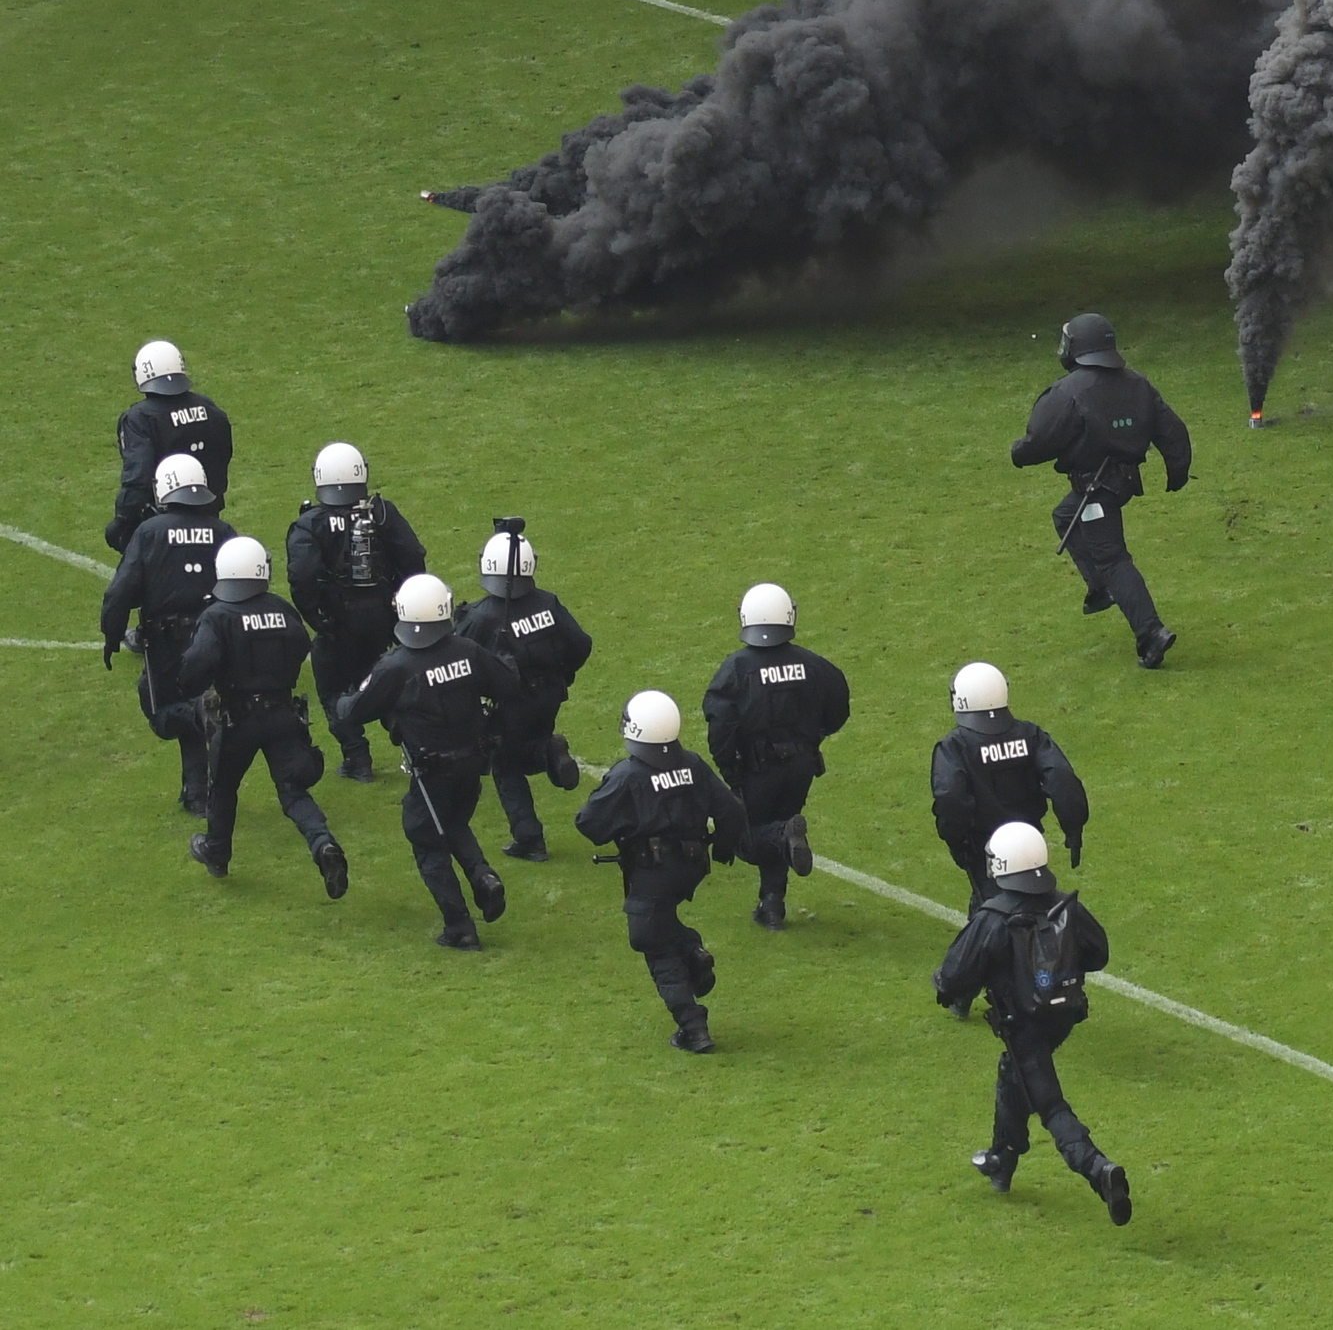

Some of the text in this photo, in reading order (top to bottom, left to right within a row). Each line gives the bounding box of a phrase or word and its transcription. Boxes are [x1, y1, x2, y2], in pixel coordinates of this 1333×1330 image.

[141, 359, 154, 374] 31
[170, 406, 208, 427] POLIZEI
[165, 470, 178, 486] 31
[353, 463, 363, 477] 31
[168, 528, 214, 546] POLIZEI
[255, 564, 266, 577] 31
[486, 559, 497, 572] 31
[521, 560, 533, 573] 31
[437, 602, 448, 617] 31
[242, 613, 287, 631] POLIZEI
[511, 610, 555, 638] POLIZEI
[426, 658, 472, 687] POLIZEI
[760, 663, 806, 685] POLIZEI
[957, 697, 968, 710] 31
[629, 722, 643, 738] 31
[980, 739, 1029, 764] POLIZEI
[650, 768, 694, 792] POLIZEI
[995, 857, 1007, 872] 31
